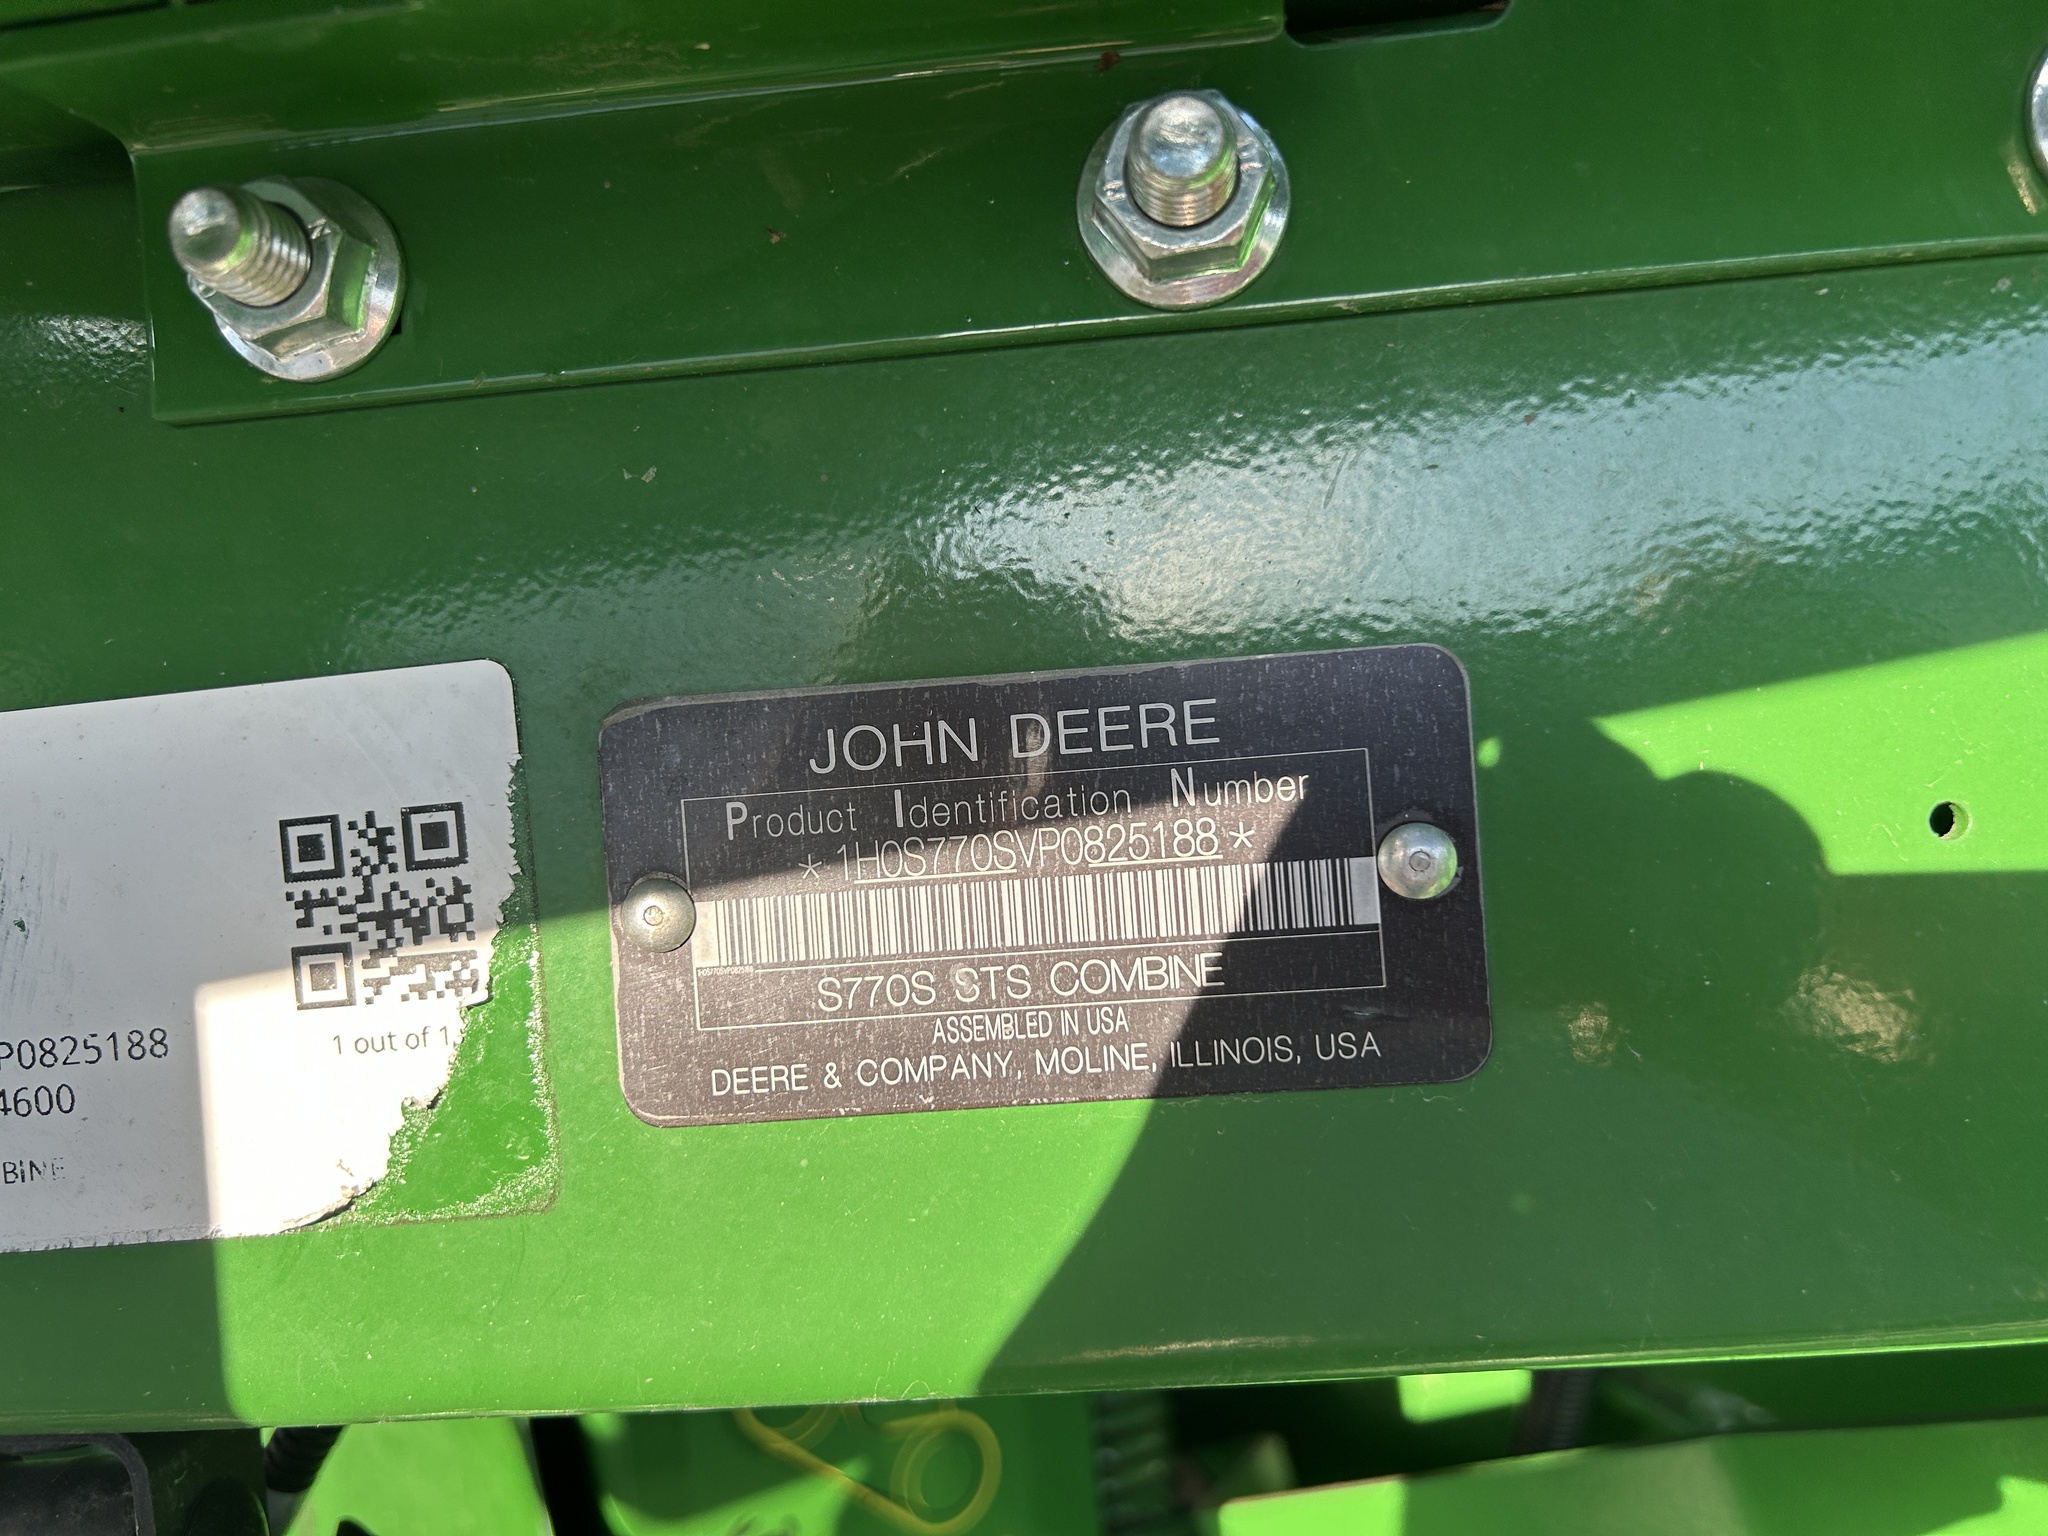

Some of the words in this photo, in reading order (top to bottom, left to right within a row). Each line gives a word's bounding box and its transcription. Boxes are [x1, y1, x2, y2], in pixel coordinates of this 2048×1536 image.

[809, 717, 979, 774] JOHN
[1010, 698, 1221, 759] DEERE
[725, 801, 857, 841] Product
[894, 784, 1132, 829] Identification
[1170, 767, 1309, 807] Number
[817, 970, 936, 1012] S770S
[955, 964, 1032, 1003] STS
[1050, 952, 1225, 996] COMBINE
[0, 1028, 169, 1071] P0825188
[333, 1034, 342, 1055] 1
[354, 1032, 398, 1054] out
[405, 1026, 431, 1050] of
[439, 1025, 449, 1046] 1
[932, 1009, 1053, 1044] ASSEMBLED
[1060, 1008, 1079, 1037] IN
[1087, 1006, 1130, 1036] USA
[711, 1063, 809, 1096] DEERE
[823, 1062, 843, 1089] &
[857, 1050, 1023, 1087] COMPANY,
[1035, 1042, 1157, 1076] MOLINE,
[1170, 1035, 1301, 1068] ILLINOIS,
[1315, 1031, 1382, 1061] USA
